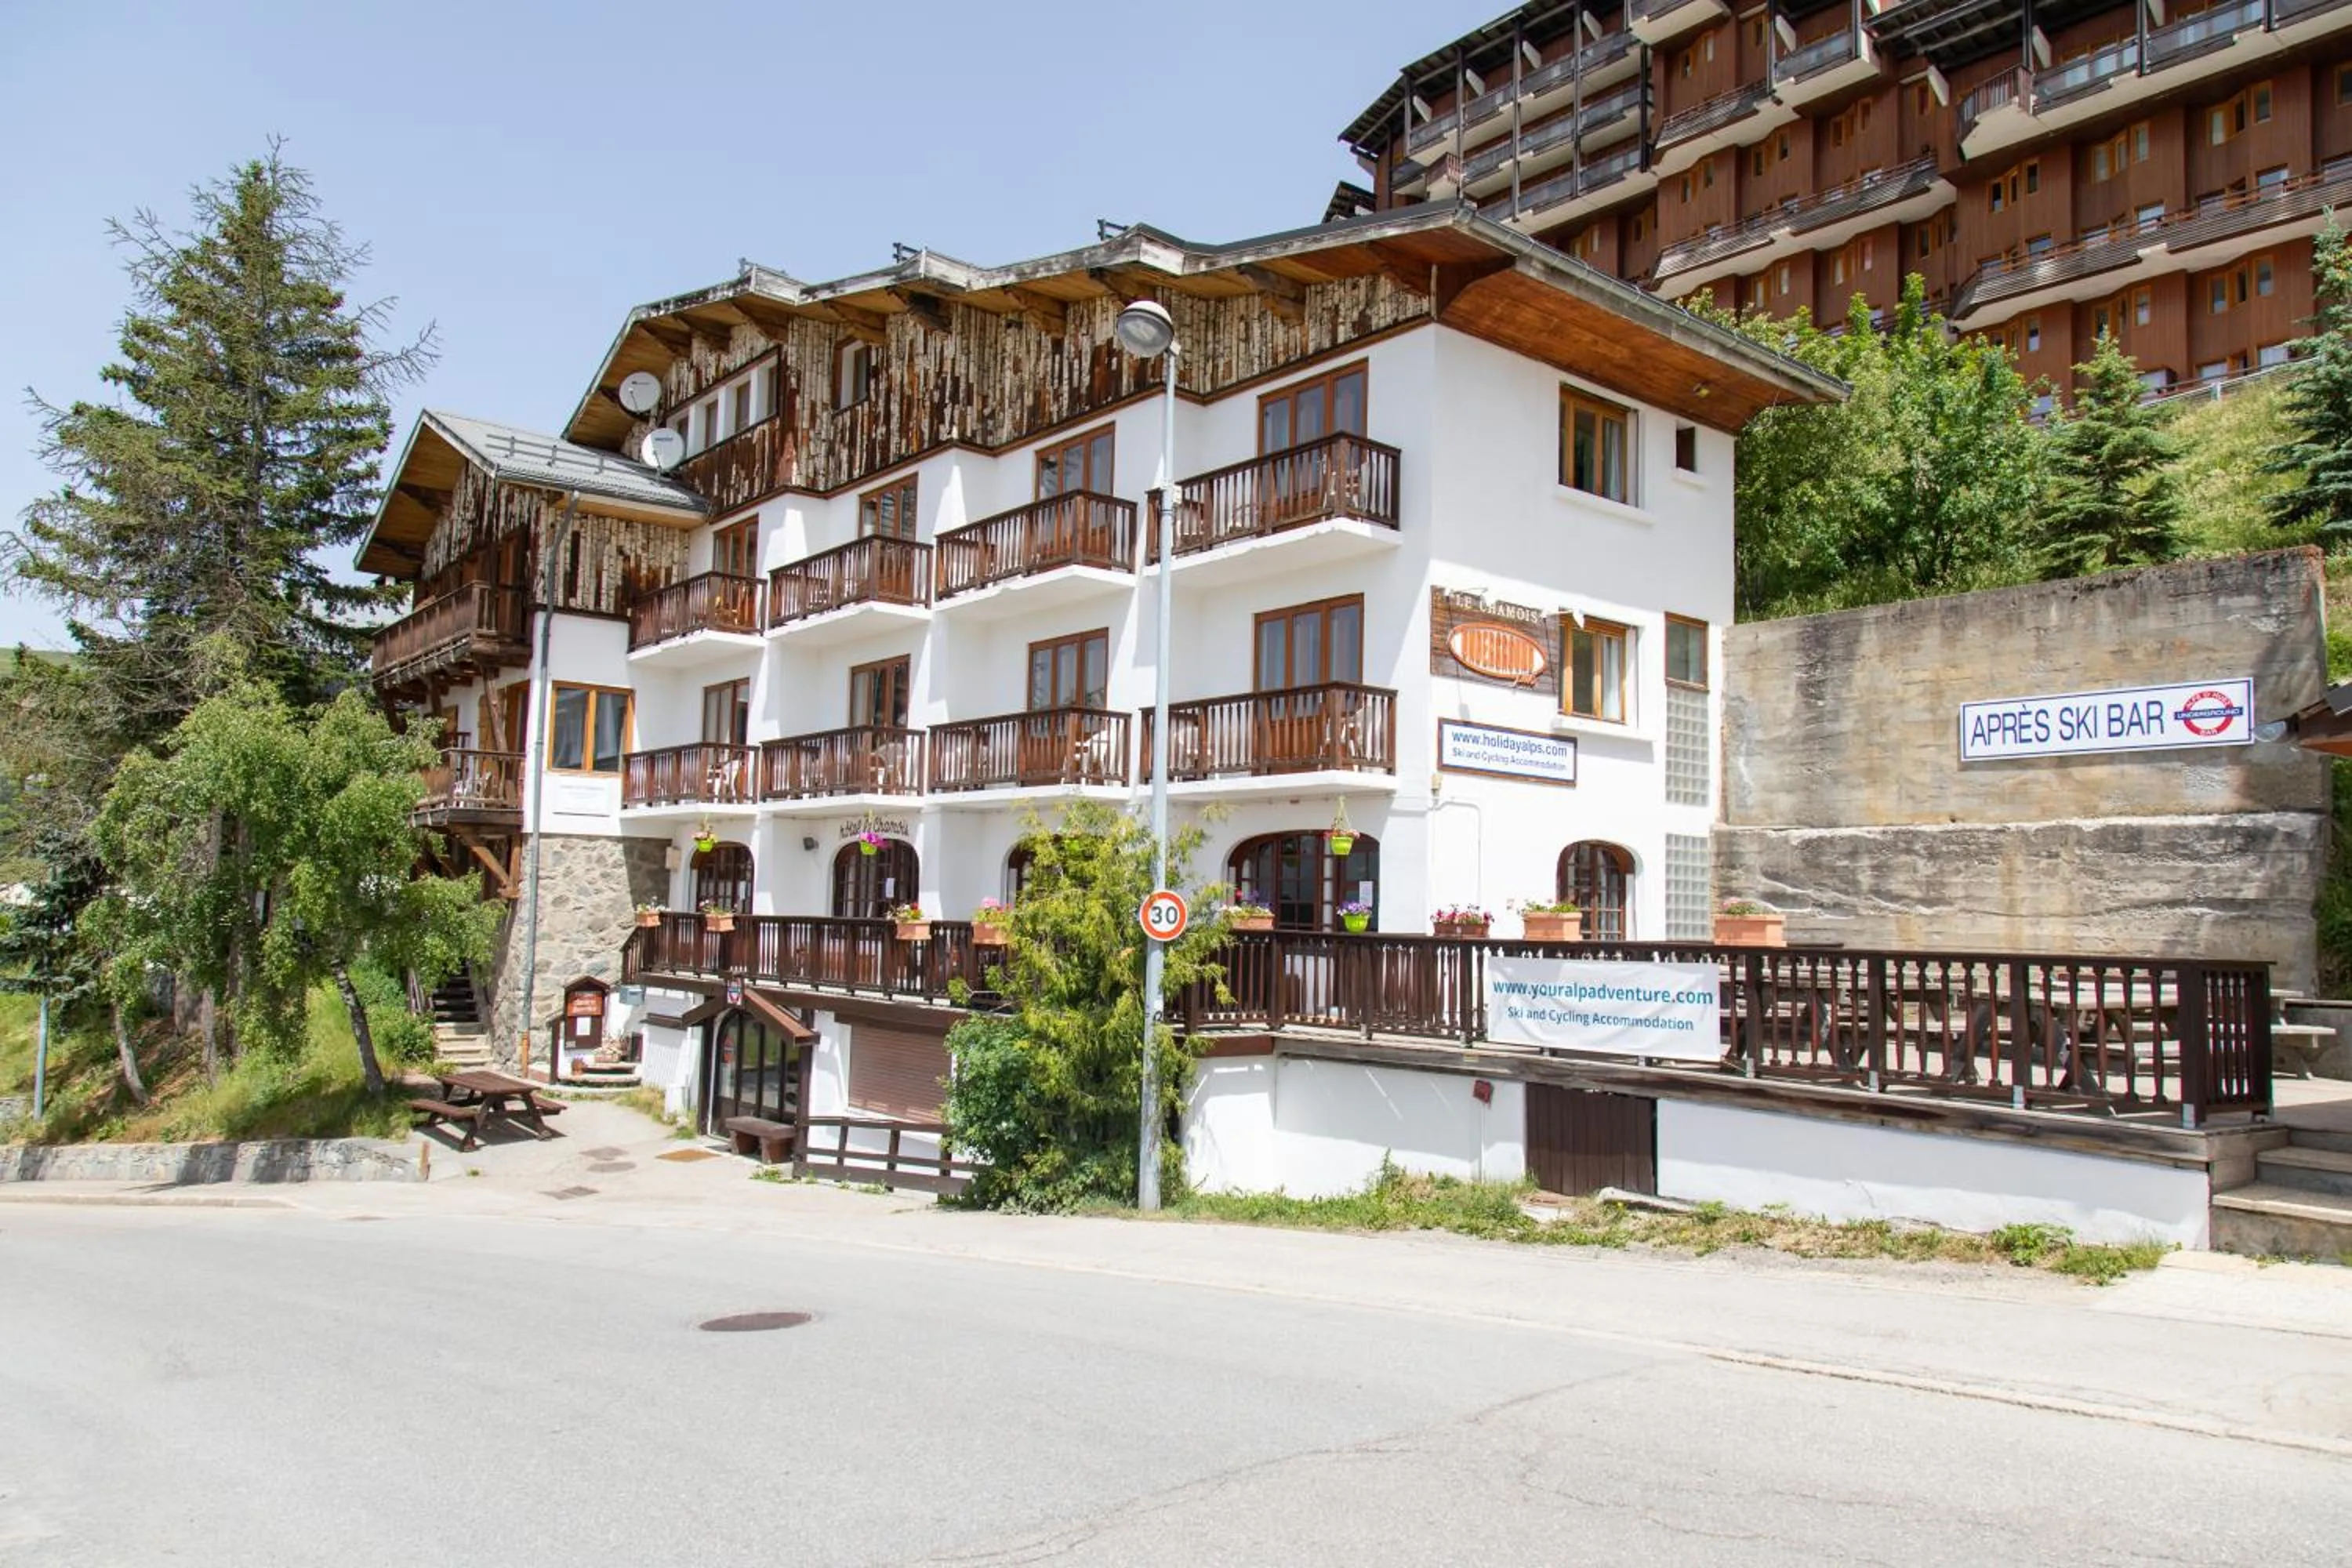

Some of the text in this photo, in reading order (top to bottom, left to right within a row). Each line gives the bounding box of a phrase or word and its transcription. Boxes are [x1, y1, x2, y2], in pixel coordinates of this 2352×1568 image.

[1456, 593, 1538, 624] LE CHAMOIS
[1970, 700, 2165, 747] APRÈS SKI BAR
[2176, 708, 2240, 719] UNDERGROUND
[1451, 731, 1567, 757] www.holidayalps.com
[1452, 747, 1464, 757] Ski
[1465, 750, 1480, 760] and
[1481, 752, 1509, 765] Cycling
[1151, 906, 1178, 924] 30
[1493, 981, 1713, 1004] www.youralpadventure.com
[1508, 1006, 1694, 1030] Ski and Cycling Accommodation
